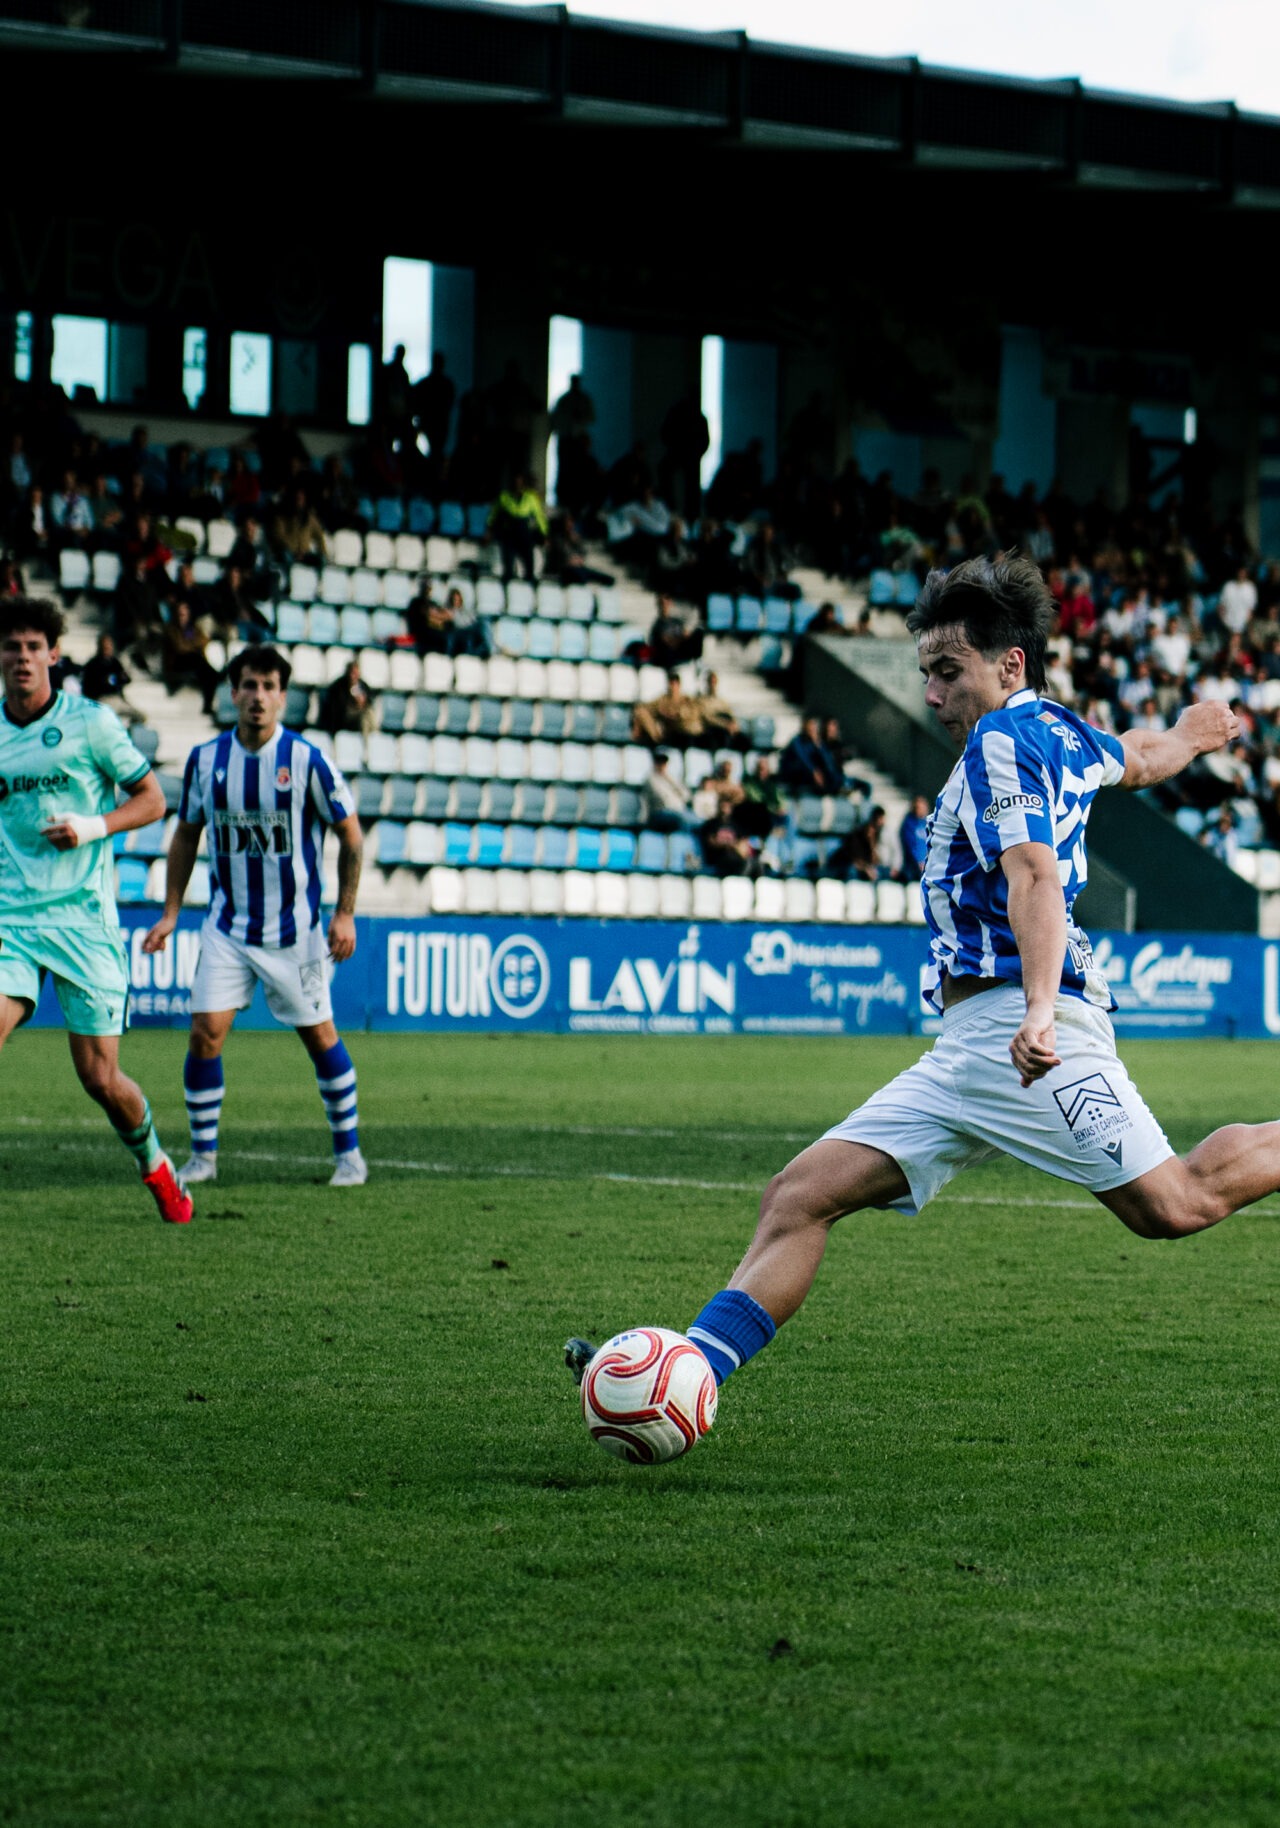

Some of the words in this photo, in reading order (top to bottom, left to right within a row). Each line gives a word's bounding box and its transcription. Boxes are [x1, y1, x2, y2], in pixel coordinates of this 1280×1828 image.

[3, 206, 226, 321] VEGA
[13, 774, 70, 792] Elproex
[984, 794, 1042, 822] adamo
[216, 824, 288, 857] DM
[1073, 1126, 1096, 1143] RENTAS
